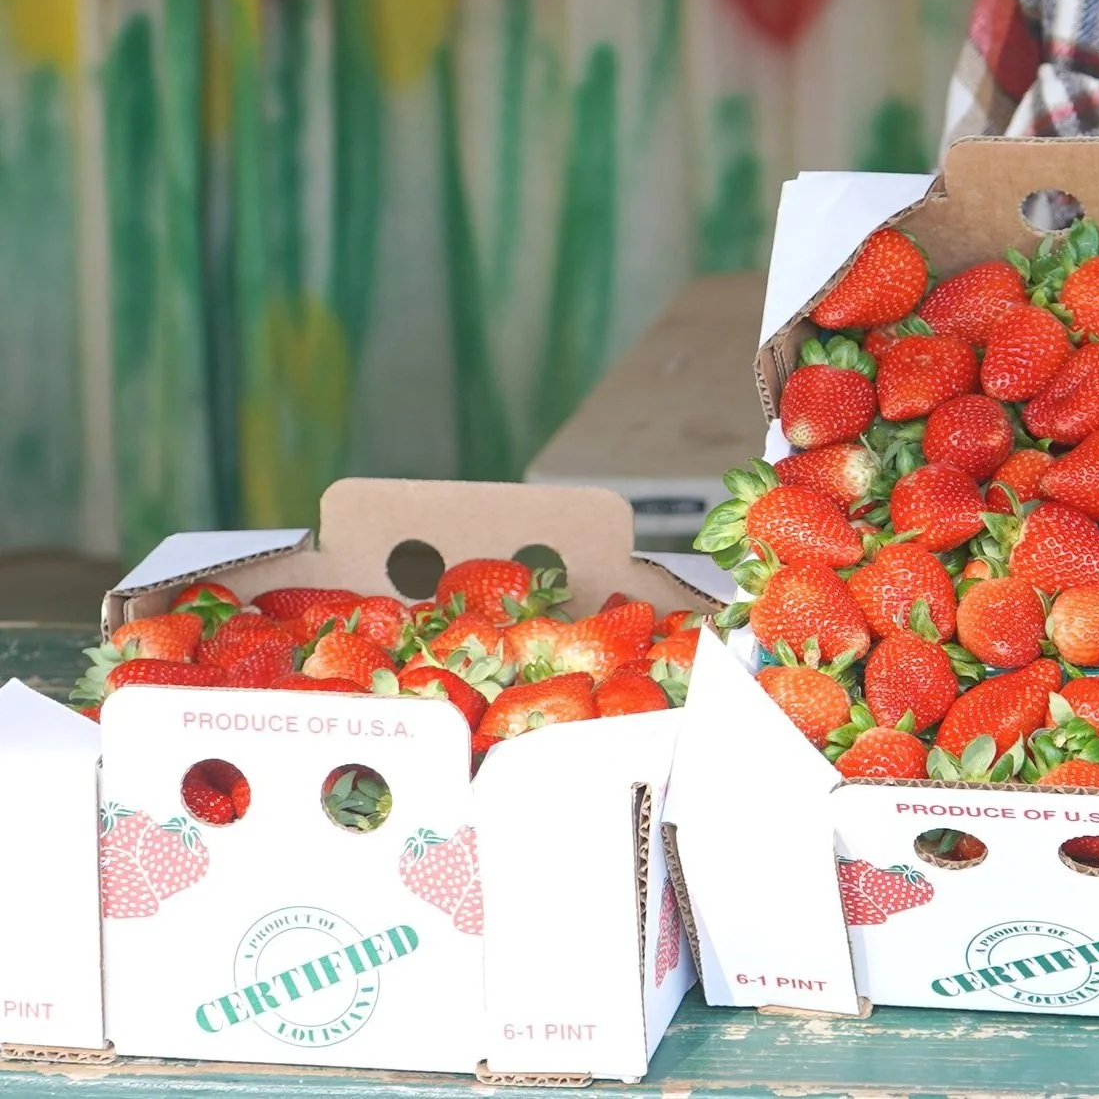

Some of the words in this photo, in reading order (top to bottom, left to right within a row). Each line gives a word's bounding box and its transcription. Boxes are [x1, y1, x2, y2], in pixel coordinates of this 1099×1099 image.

[183, 711, 300, 733] PRODUCE
[307, 717, 338, 734] OF
[347, 719, 416, 739] U.S.A.
[895, 803, 1017, 819] PRODUCE
[1024, 809, 1057, 821] OF
[248, 914, 314, 950] PRODUCT
[318, 917, 337, 931] OF
[979, 925, 1044, 948] PRODUCT
[1047, 927, 1070, 939] OF
[974, 947, 987, 956] A
[195, 923, 421, 1034] CERTIFIED
[736, 973, 767, 986] 6-1
[776, 976, 828, 992] PINT
[4, 1000, 54, 1020] PINT
[276, 985, 376, 1043] LOUISIANA
[503, 1023, 533, 1040] 6-1
[545, 1023, 598, 1041] PINT
